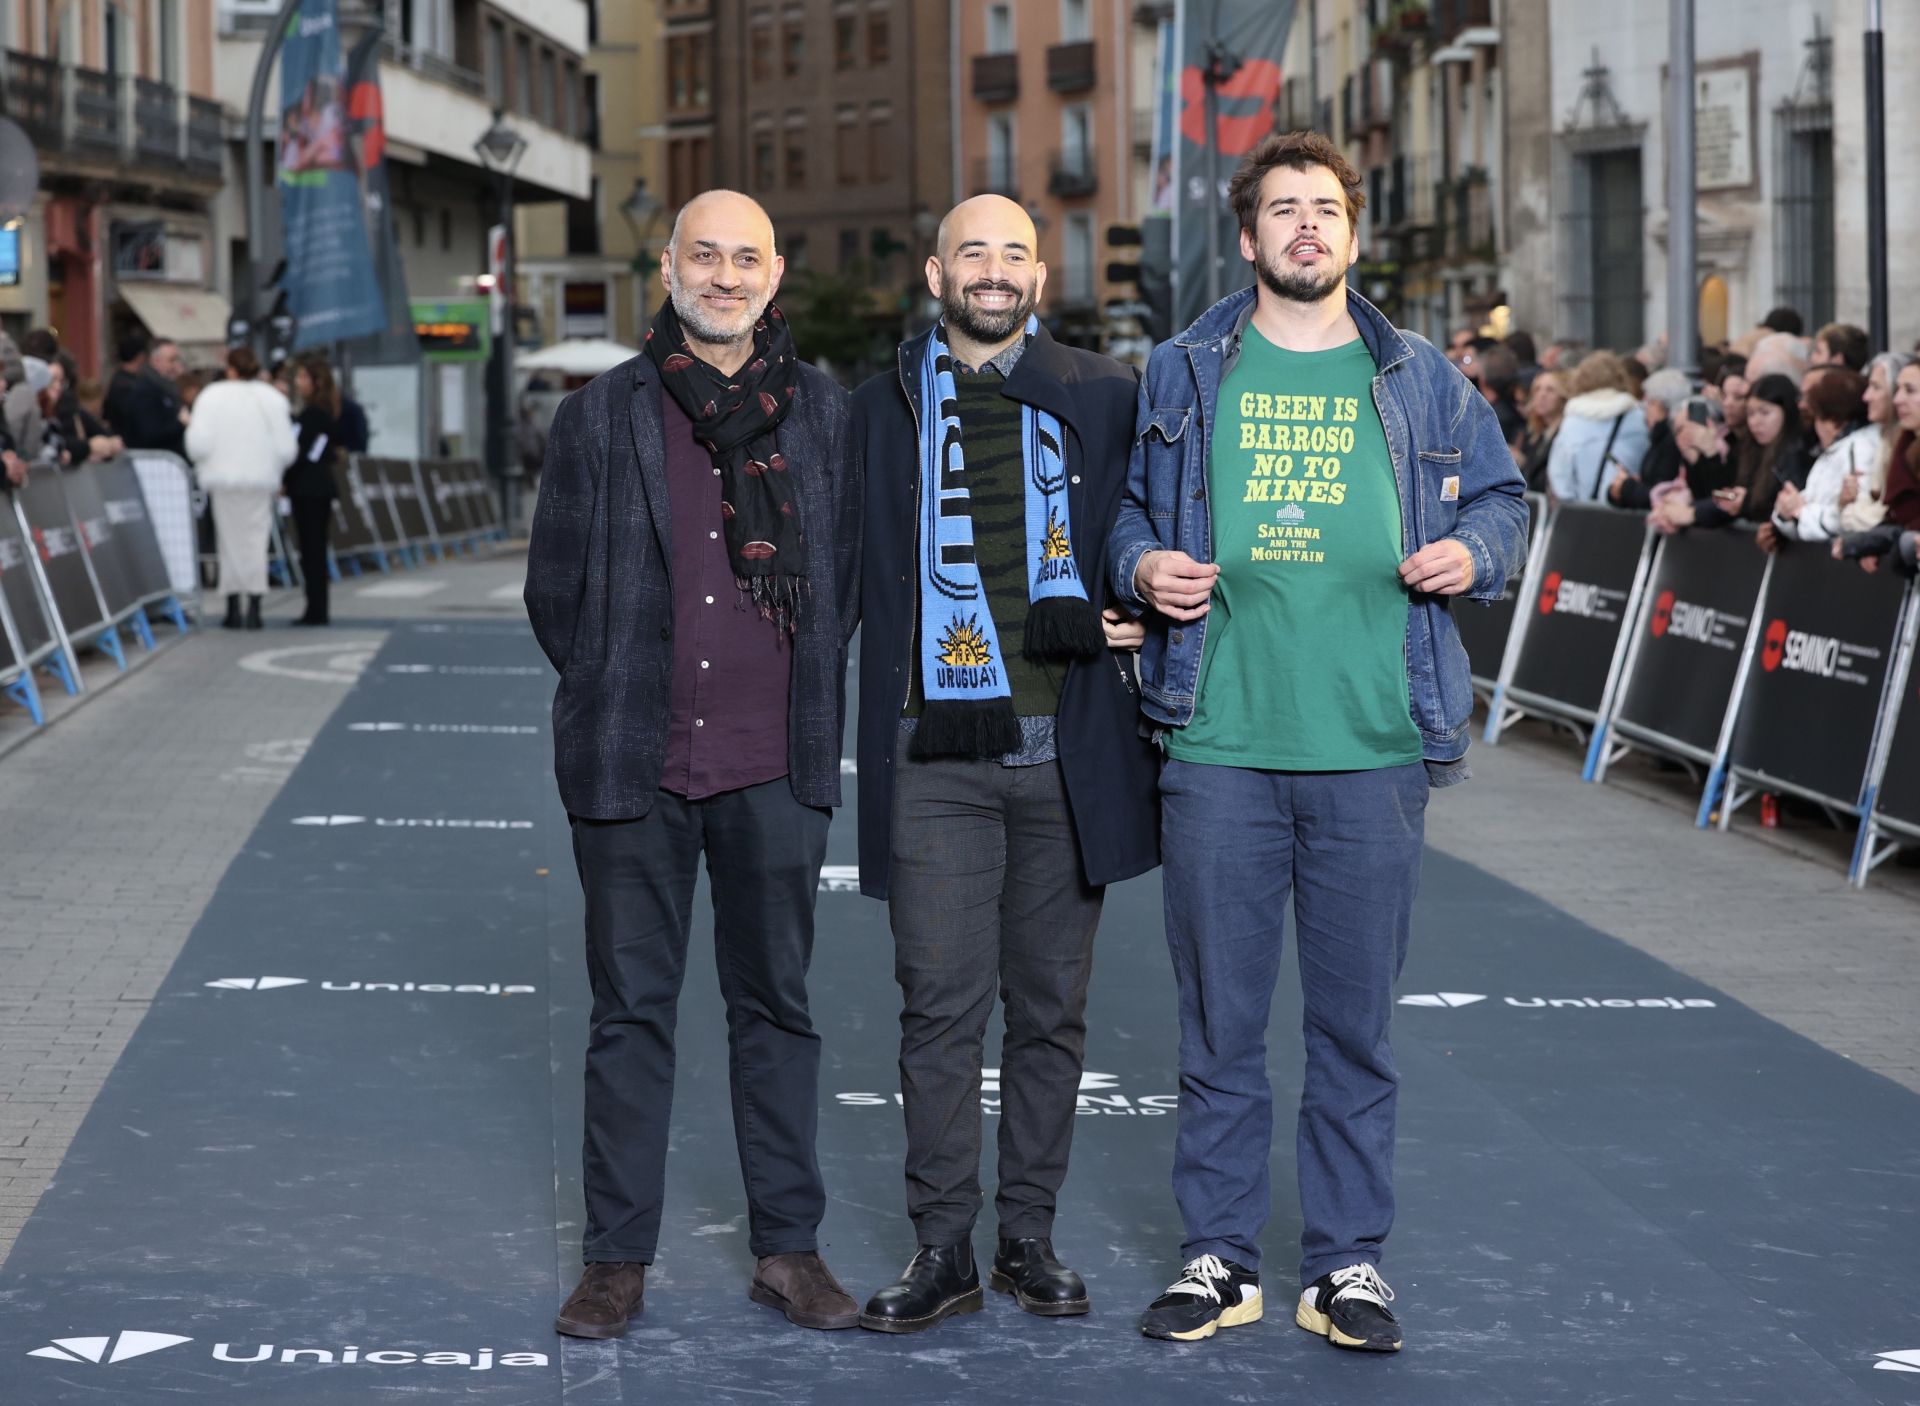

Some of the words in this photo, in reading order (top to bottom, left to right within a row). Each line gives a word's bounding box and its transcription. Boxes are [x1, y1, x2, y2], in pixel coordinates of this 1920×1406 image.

[1240, 392, 1327, 421] GREEN
[1333, 397, 1358, 422] IS
[1240, 423, 1355, 454] BARROSO
[1252, 453, 1293, 477] NO
[1303, 456, 1341, 480] TO
[1243, 479, 1347, 505] MINES
[1258, 524, 1320, 539] SAVANNA
[1251, 547, 1325, 562] MOUNTAIN
[1270, 540, 1288, 548] AND
[1291, 540, 1307, 548] THE
[936, 667, 998, 689] URUGUAY
[321, 980, 537, 994] Unicaja
[1504, 996, 1716, 1009] Unicaja
[212, 1343, 549, 1371] Unicaja
